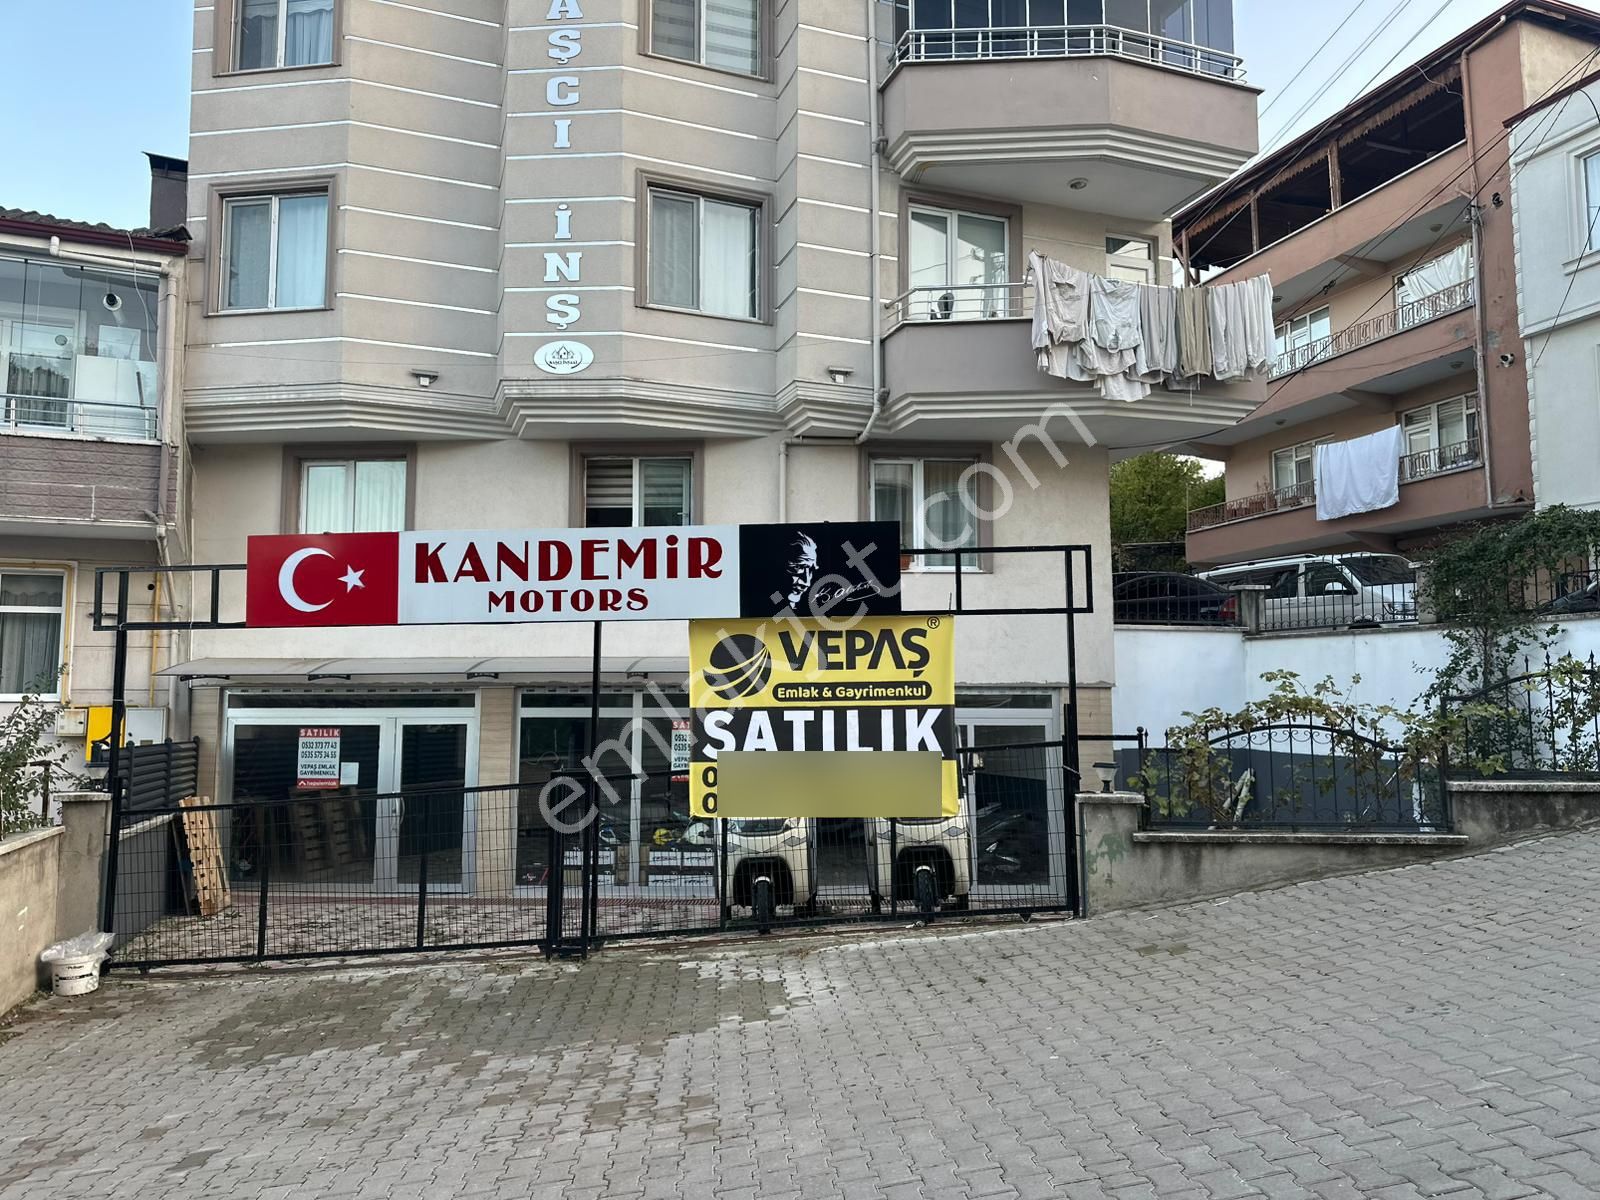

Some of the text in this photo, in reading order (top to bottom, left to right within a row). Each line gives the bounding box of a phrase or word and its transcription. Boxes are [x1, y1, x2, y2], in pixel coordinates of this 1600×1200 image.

[543, 203, 582, 330] İNŞ
[488, 587, 648, 613] MOTORS
[778, 627, 930, 678] VEPAŞ
[777, 685, 926, 700] Emlak & Gayrimenkul
[702, 708, 944, 761] SATILIK
